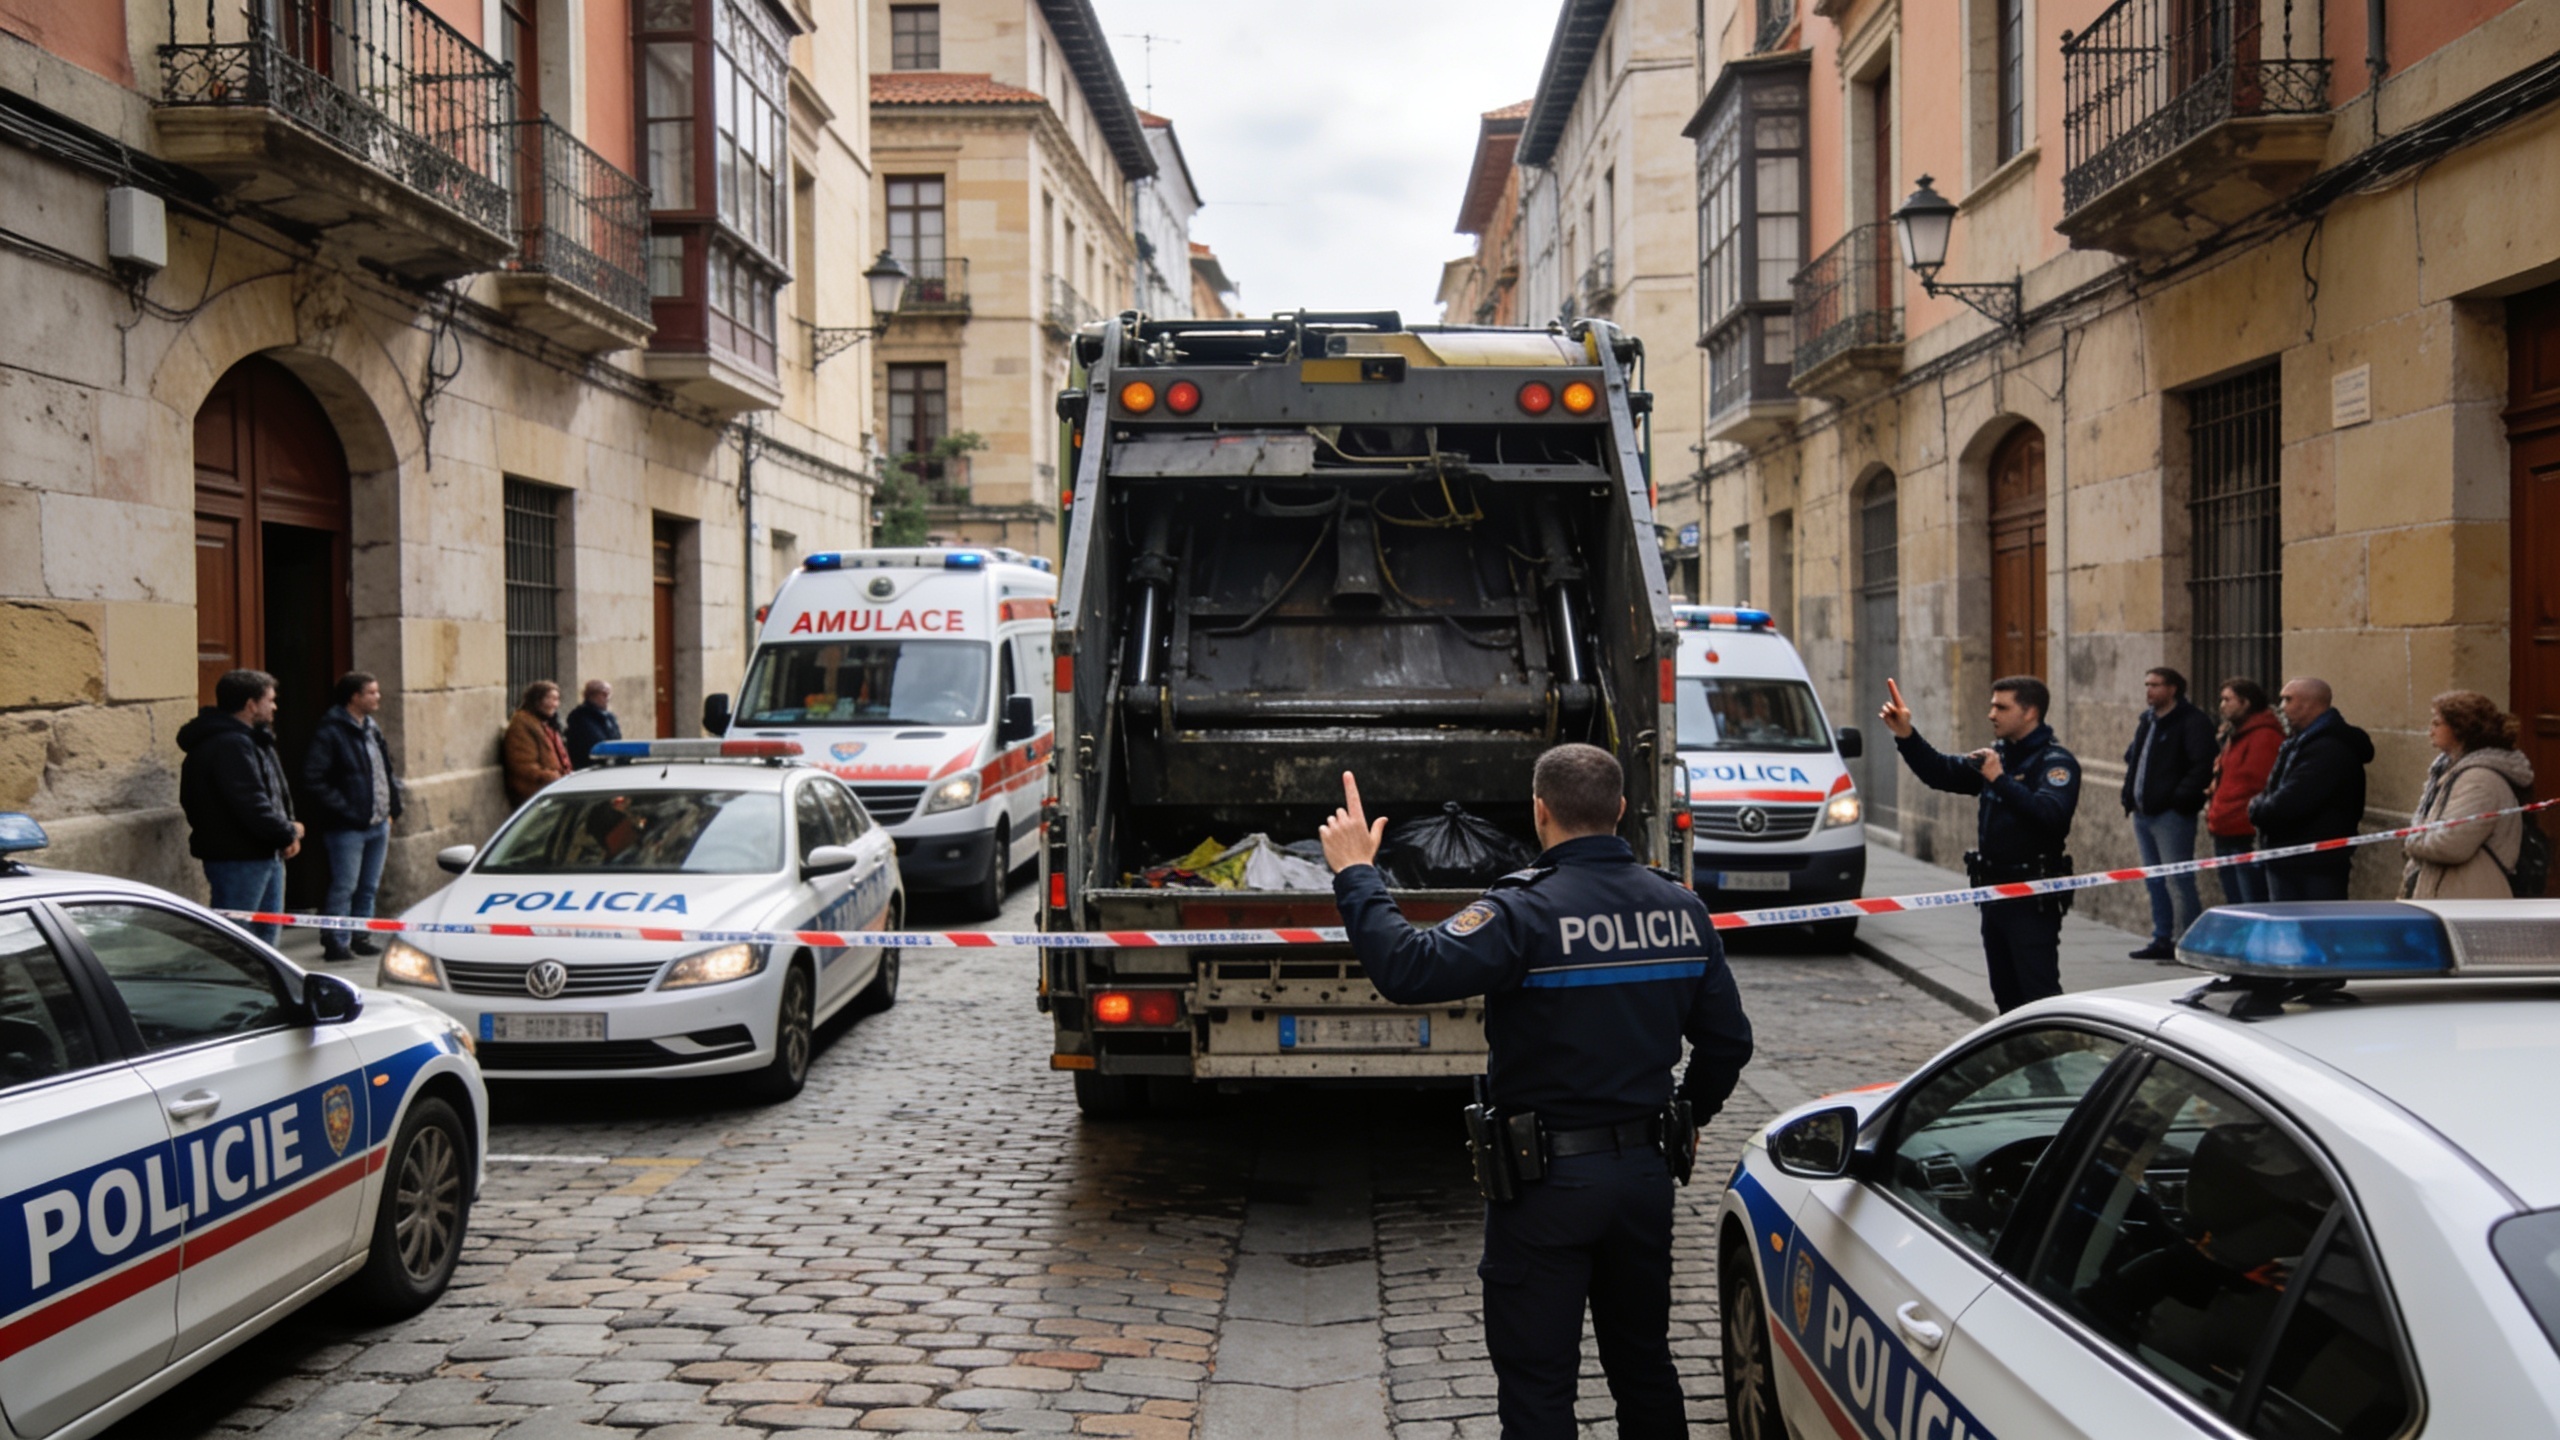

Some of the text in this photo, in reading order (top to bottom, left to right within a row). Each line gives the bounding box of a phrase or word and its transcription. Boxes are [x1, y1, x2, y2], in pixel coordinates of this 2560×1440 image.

[790, 609, 965, 634] AMULACE
[475, 890, 688, 915] POLICIA
[1559, 909, 1701, 955] POLICIA
[22, 1102, 303, 1291] POLICIE
